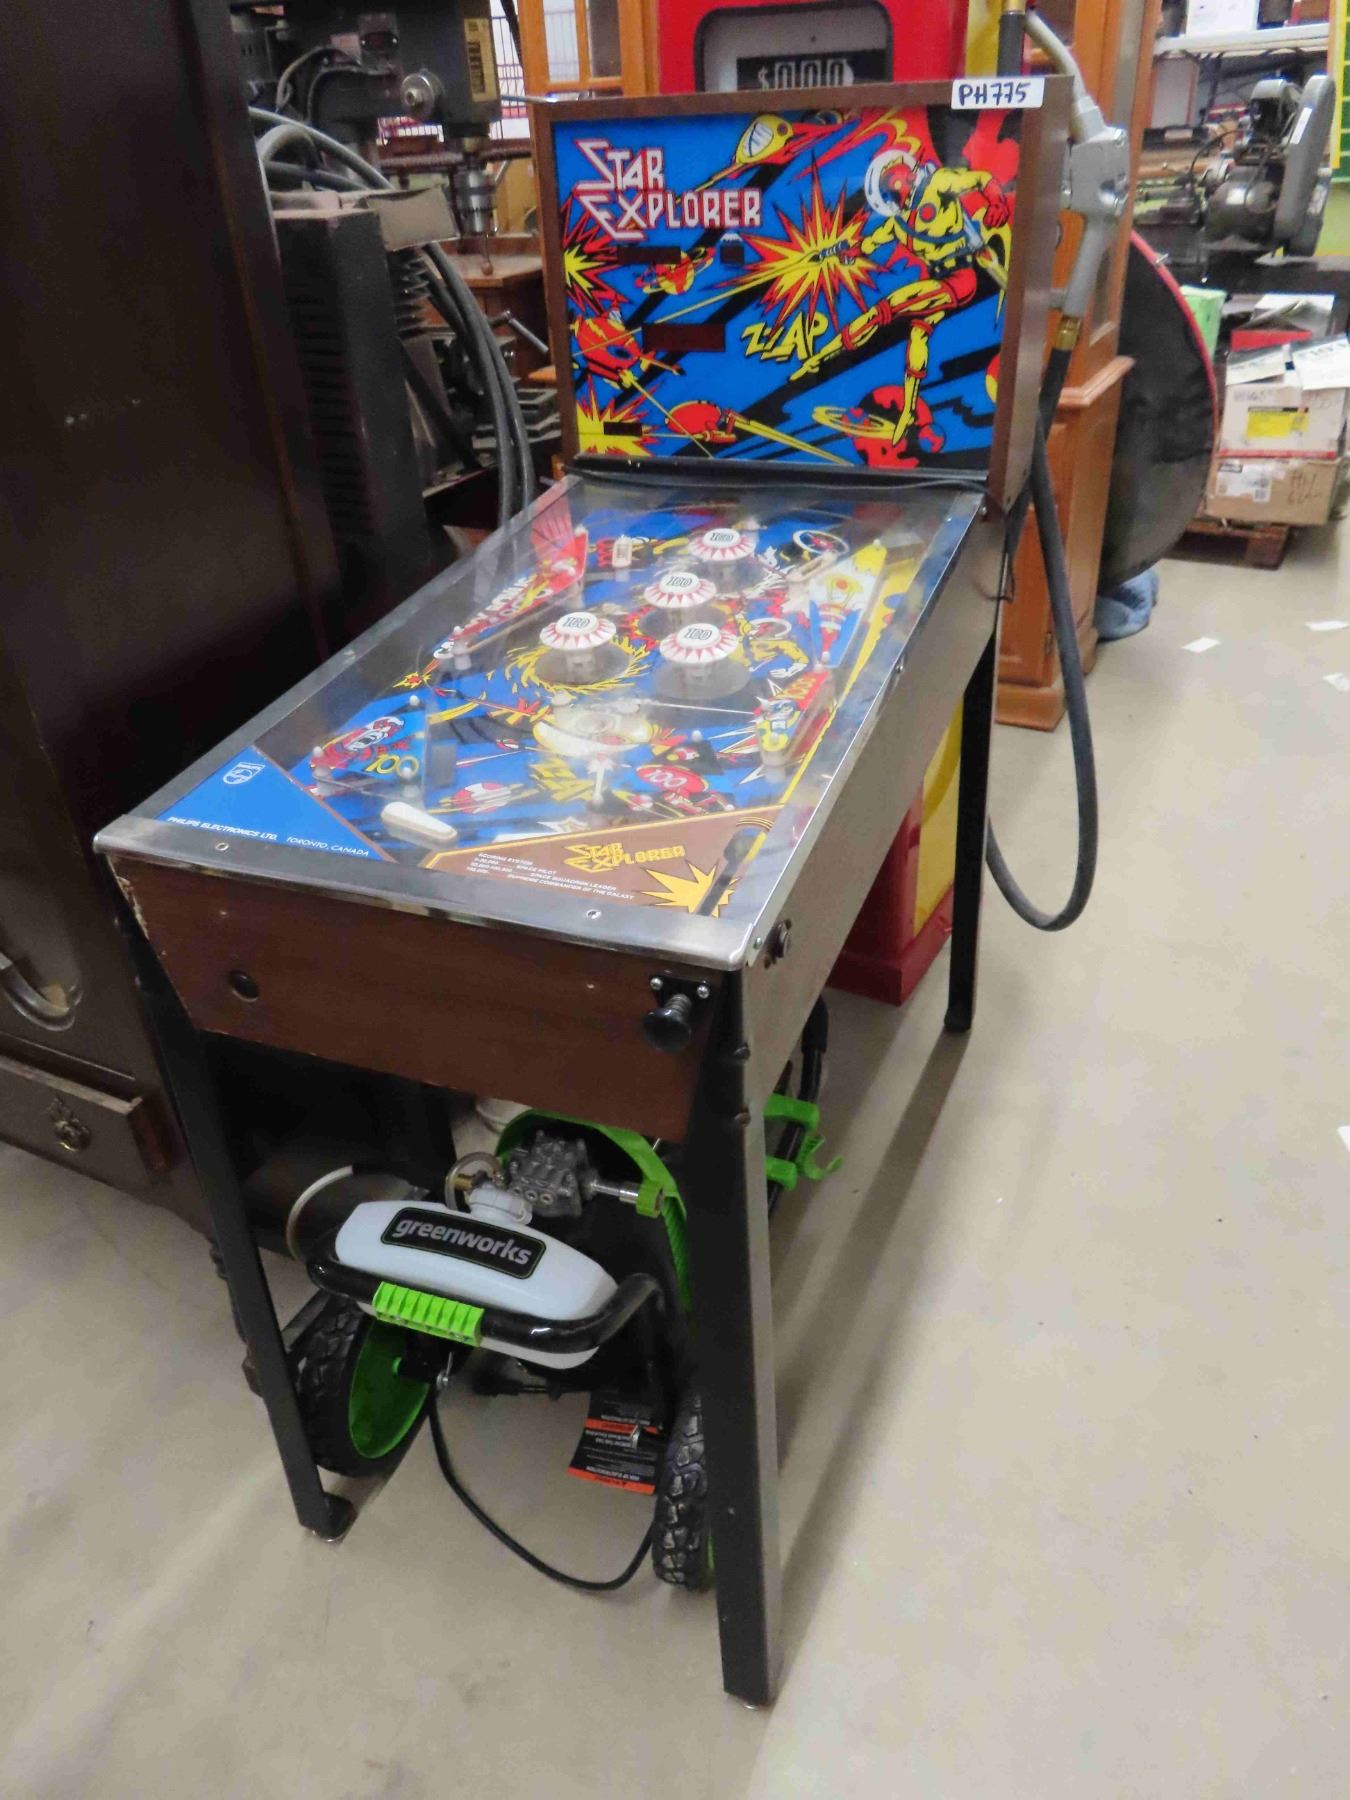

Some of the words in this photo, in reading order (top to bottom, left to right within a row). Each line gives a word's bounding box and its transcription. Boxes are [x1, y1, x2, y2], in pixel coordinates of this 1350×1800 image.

[958, 82, 1031, 106] PH775
[574, 138, 665, 192] STAR
[574, 188, 762, 240] EXPLORER
[167, 816, 201, 828] PHILIPS
[201, 822, 259, 838] ELECTRONICS
[331, 844, 369, 857] CANADA
[563, 842, 623, 858] STAR
[392, 1218, 532, 1265] greenworks
